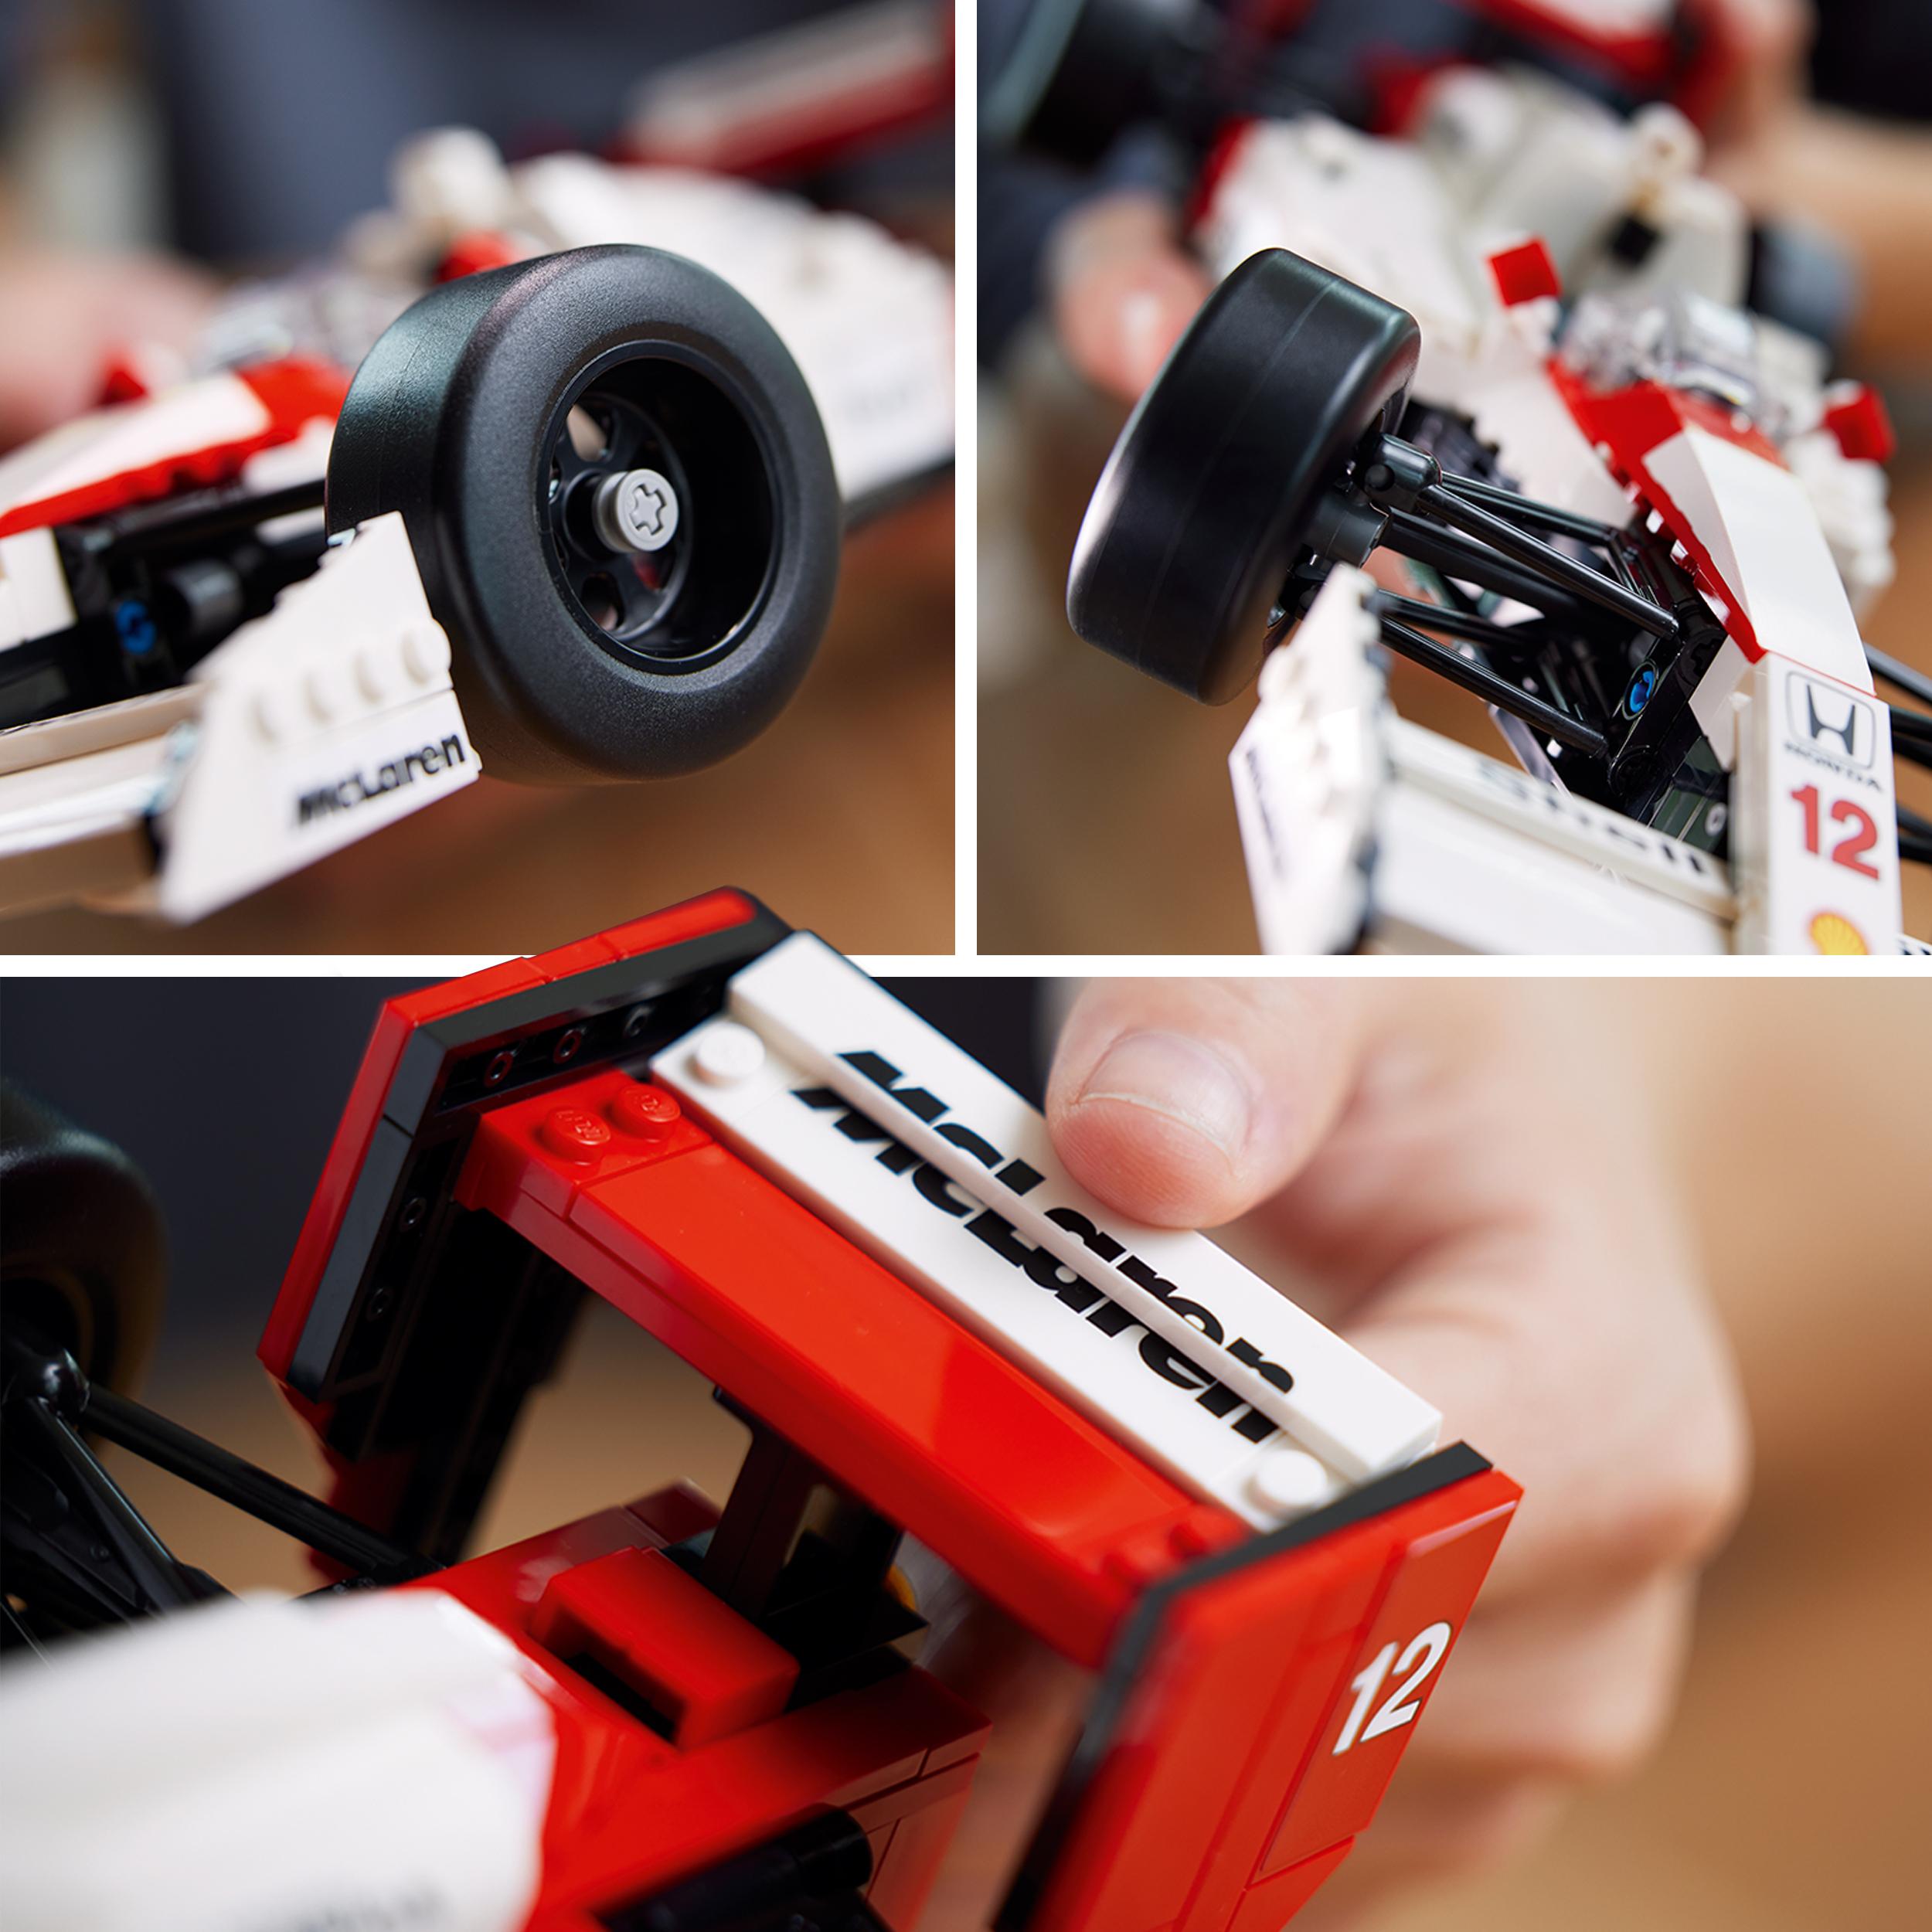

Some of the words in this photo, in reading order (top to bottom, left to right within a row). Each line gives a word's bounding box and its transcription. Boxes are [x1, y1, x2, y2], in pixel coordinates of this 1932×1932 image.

[298, 733, 465, 825] McLaren
[1783, 742, 1883, 794] HONDA
[1789, 784, 1880, 881] 12
[787, 1050, 1295, 1444] McLaren
[1332, 1621, 1451, 1756] 12
